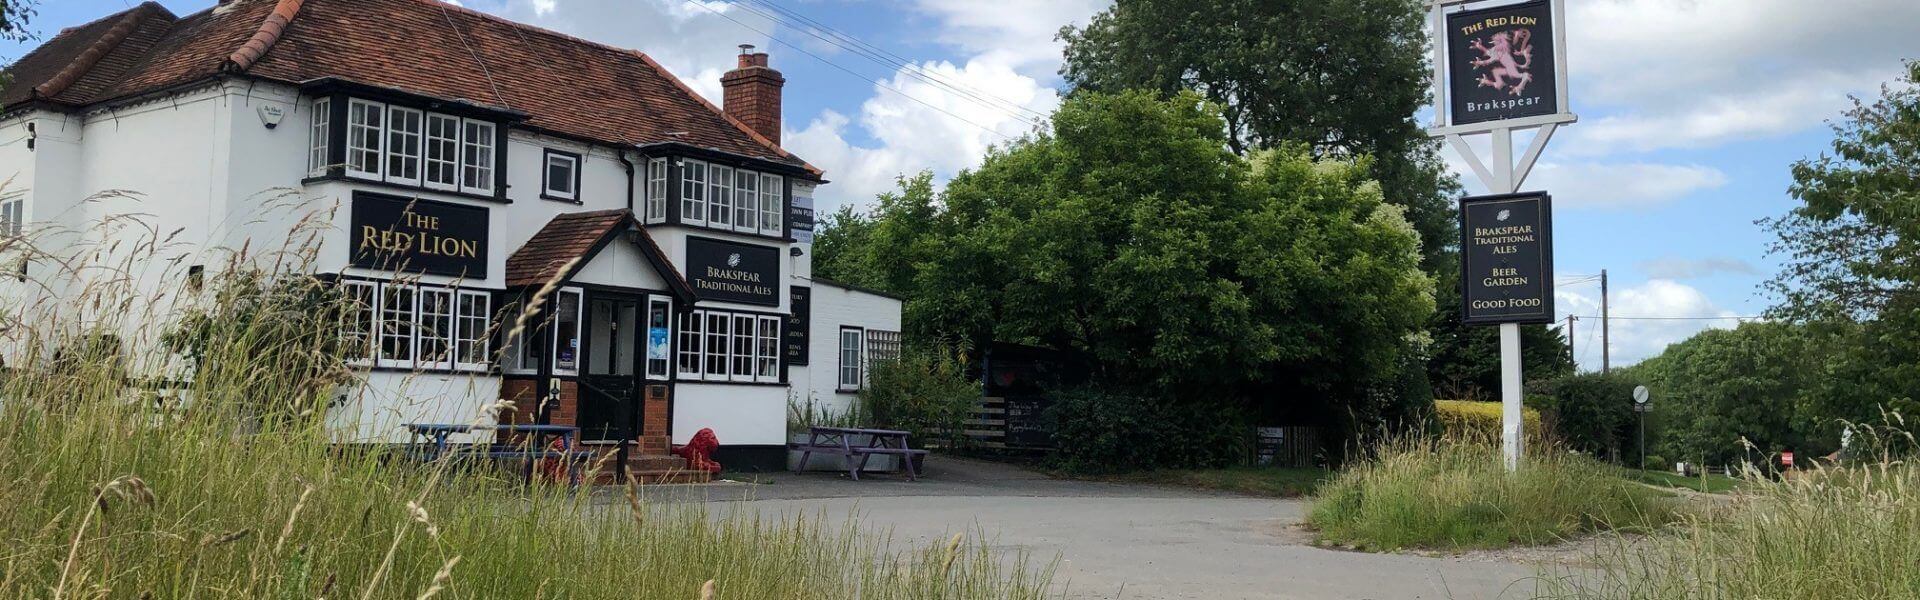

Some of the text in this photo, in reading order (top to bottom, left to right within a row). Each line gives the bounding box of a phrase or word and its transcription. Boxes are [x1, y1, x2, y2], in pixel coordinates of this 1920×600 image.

[1461, 15, 1537, 35] THE RED LION
[1467, 96, 1540, 112] Brakspear
[406, 211, 439, 230] THE
[1475, 225, 1533, 237] BRAKSPEAR
[362, 225, 477, 258] RED LION
[1474, 235, 1535, 245] TRADITIONAL
[1493, 245, 1517, 254] ALES
[707, 266, 760, 283] BRAKSPEAR
[1492, 267, 1518, 277] BEER
[695, 278, 772, 296] TRADITIONAL ALES
[1483, 277, 1528, 287] GARDEN
[1472, 298, 1540, 309] GOOD FOOD
